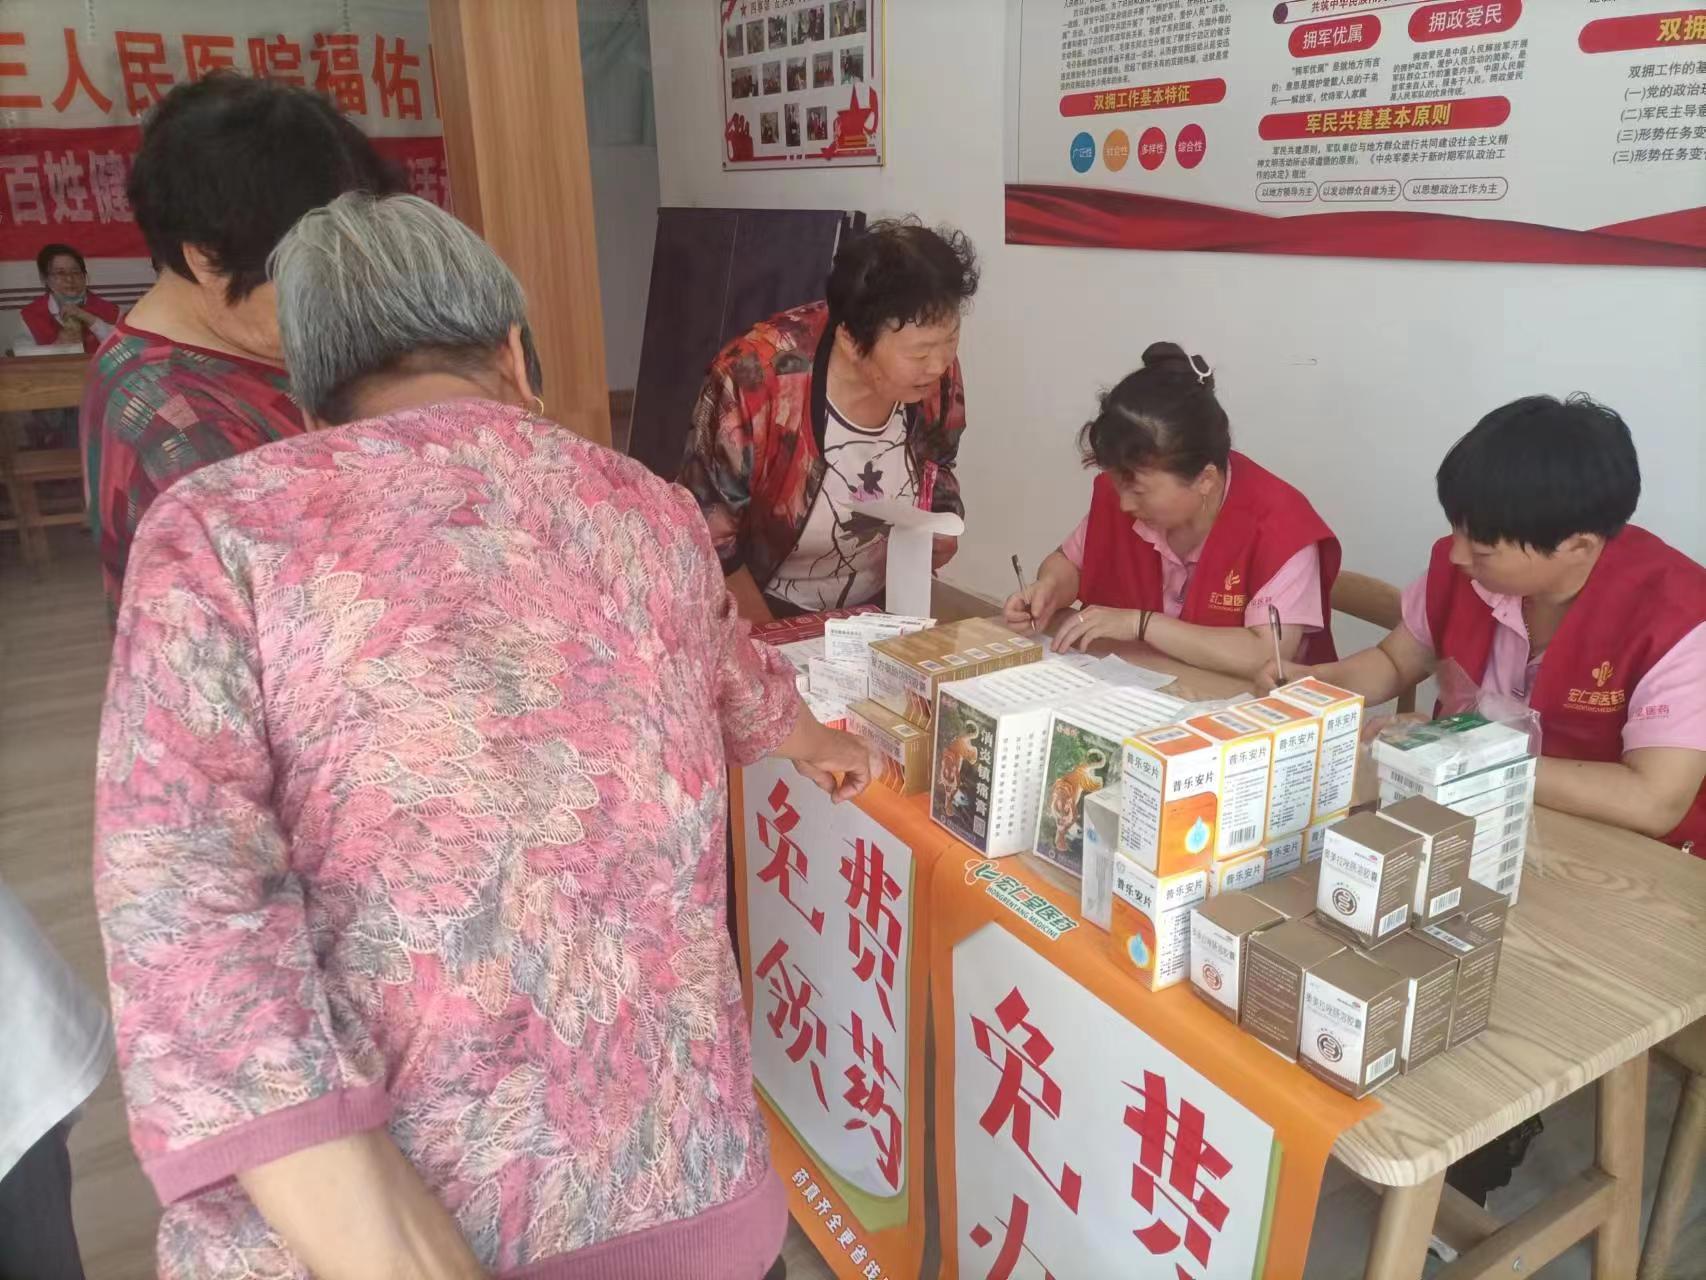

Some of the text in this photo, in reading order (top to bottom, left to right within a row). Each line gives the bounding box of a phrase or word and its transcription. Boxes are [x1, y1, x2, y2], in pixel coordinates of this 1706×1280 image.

[1429, 4, 1502, 32] 拥政爱民
[1656, 14, 1706, 42] 双拥
[1302, 24, 1363, 49] 拥军优属
[1093, 85, 1191, 111] 双拥工作基本特征
[1305, 103, 1452, 134] 军民共建基本原则
[1612, 146, 1706, 165] (三)形势任务变
[1412, 183, 1498, 196] 以思想政治工作为主
[1327, 711, 1358, 731] 普乐安片
[1279, 732, 1317, 750] 普乐安片
[1127, 752, 1159, 780] 普乐安片
[1228, 746, 1267, 766] 普乐安片
[1173, 770, 1215, 793] 普乐安片
[1268, 840, 1298, 857] 乐安片
[1226, 863, 1262, 885] 普乐安片
[1117, 878, 1153, 909] 普乐安片
[1166, 880, 1204, 901] 普乐安片
[987, 886, 1059, 939] HONGRENTANG MEDICINE
[990, 875, 1079, 932] 宏仁堂医药
